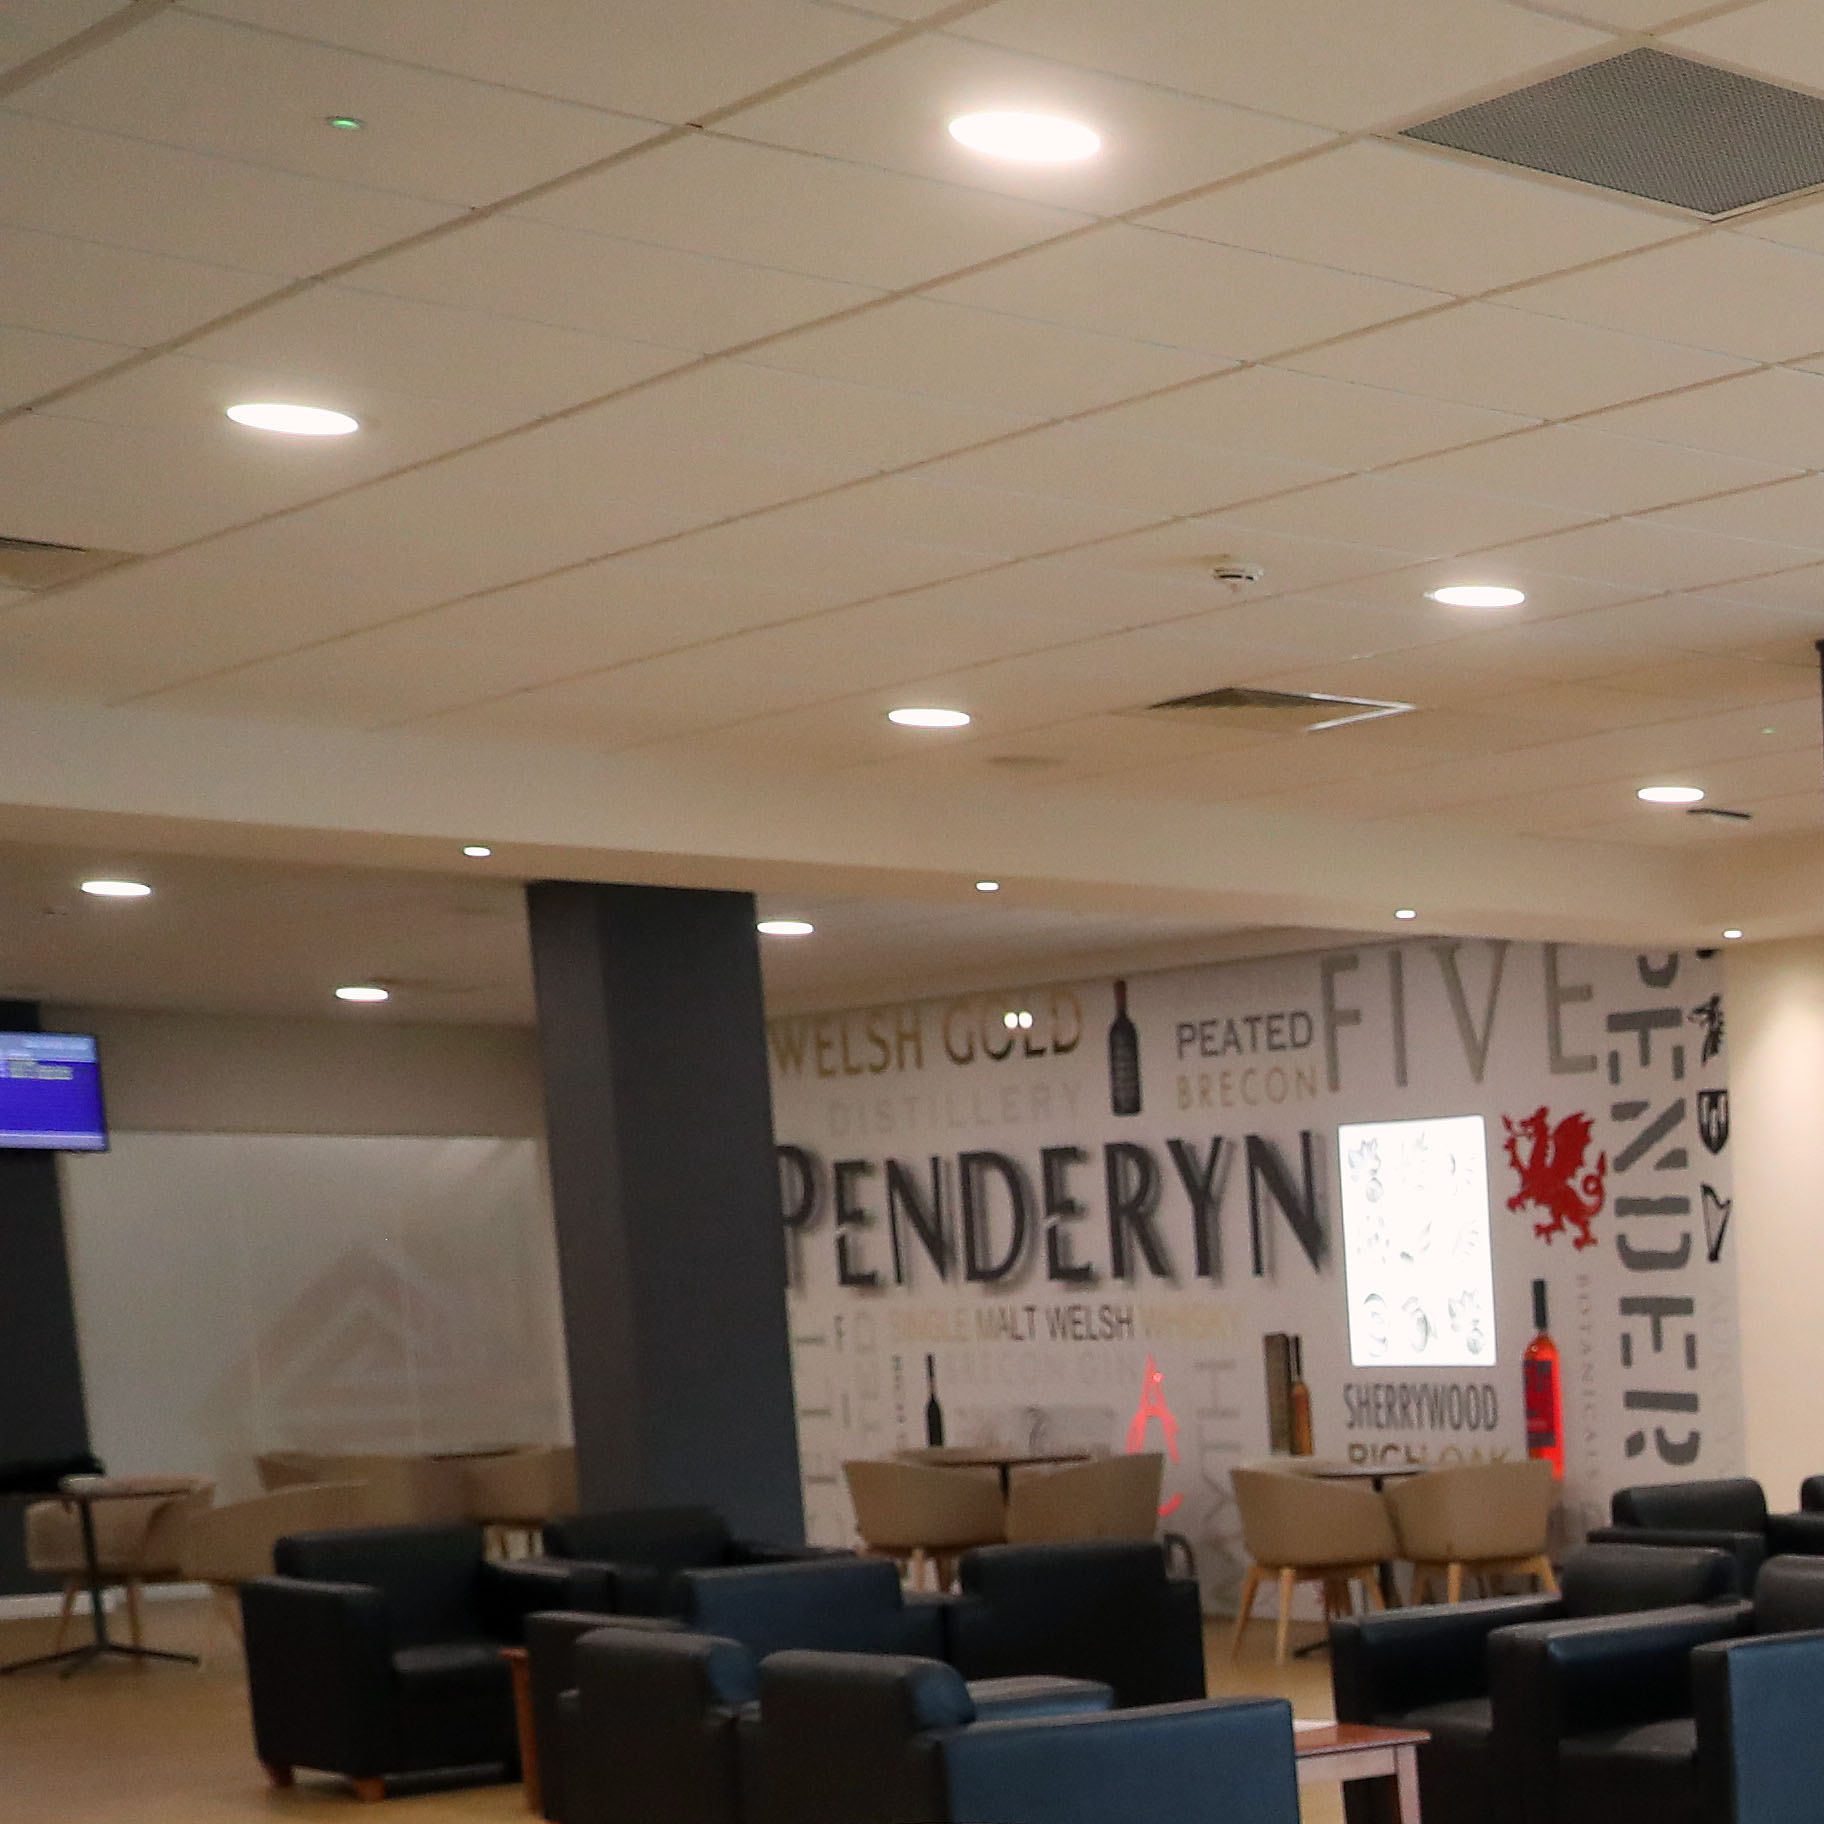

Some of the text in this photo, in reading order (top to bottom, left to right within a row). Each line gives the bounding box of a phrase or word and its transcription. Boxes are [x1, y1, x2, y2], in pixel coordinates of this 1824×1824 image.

[769, 988, 1084, 1079] WELSH GOLD
[1177, 1010, 1313, 1059] PEATED
[1321, 939, 1598, 1093] FIVE
[827, 1080, 1084, 1138] DISTILLERY
[1178, 1065, 1318, 1111] BRECON
[776, 1130, 1327, 1288] PENDERYN
[975, 1305, 1037, 1341] MALT
[1045, 1303, 1136, 1341] WELSH
[1343, 1381, 1499, 1431] SHERRYWOOD
